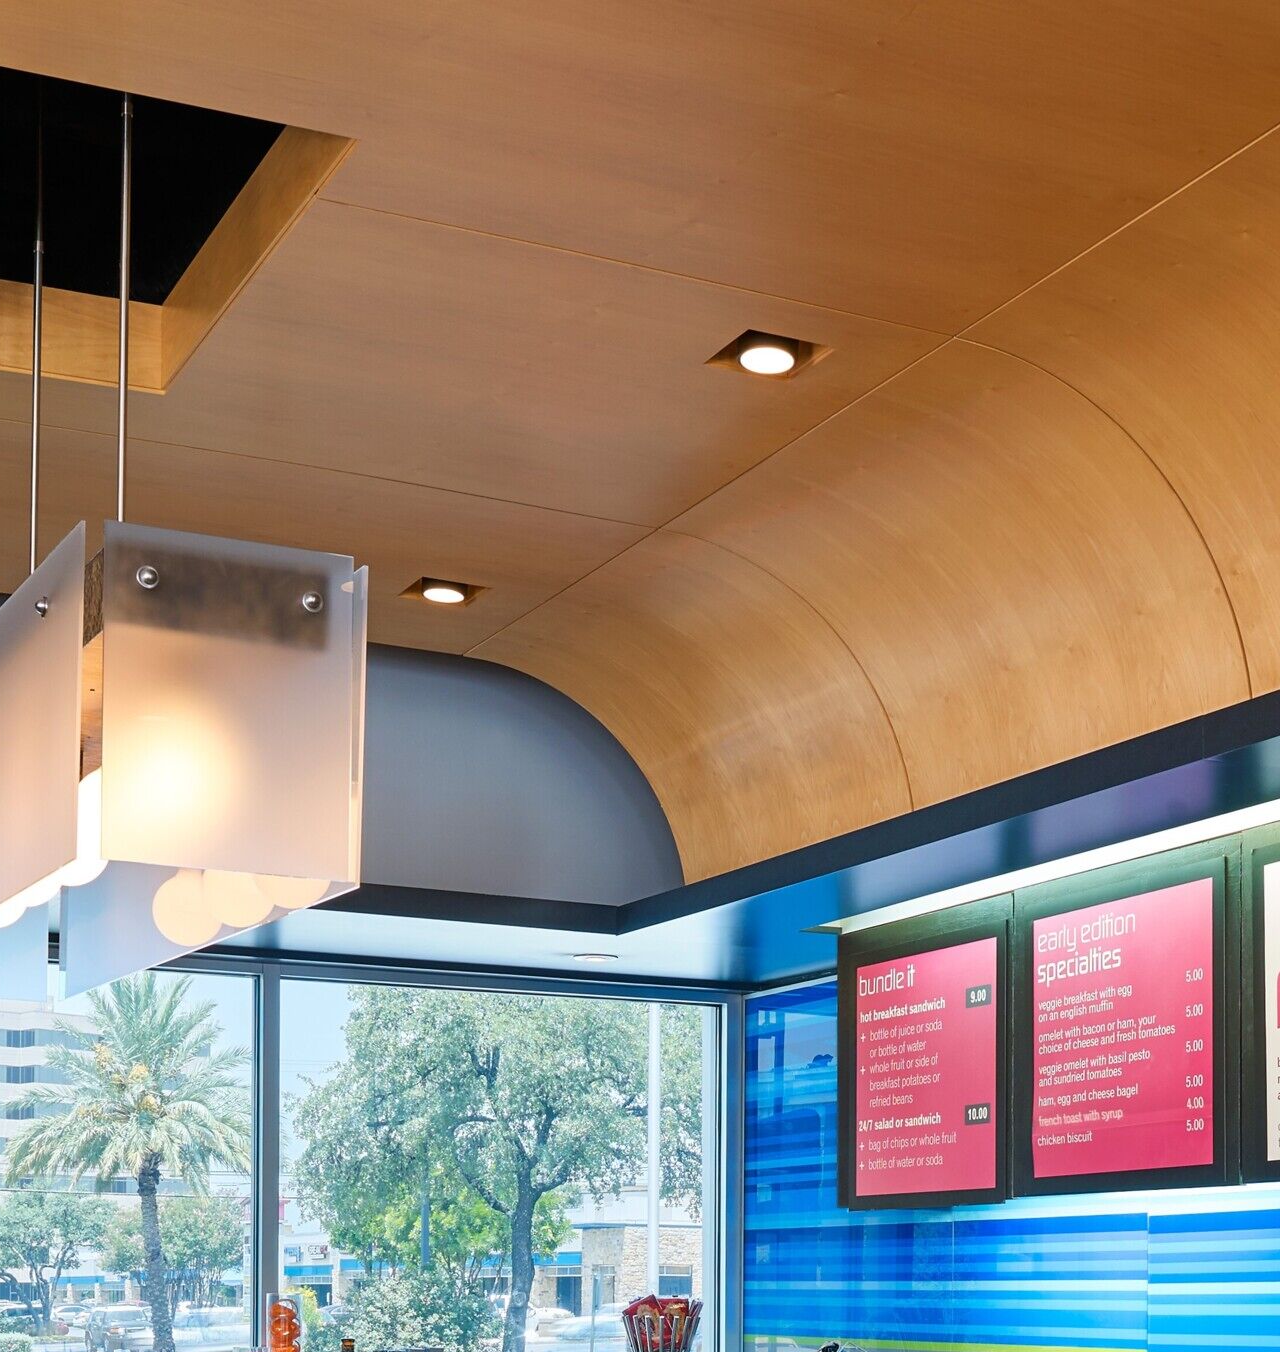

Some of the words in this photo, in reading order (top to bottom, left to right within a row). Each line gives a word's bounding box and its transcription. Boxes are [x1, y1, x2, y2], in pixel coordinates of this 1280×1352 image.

[1038, 926, 1076, 952] early
[1081, 913, 1135, 943] edition
[860, 968, 904, 996] bundle
[907, 964, 915, 987] it
[1038, 948, 1121, 986] specialties
[1039, 998, 1062, 1011] veggie
[1064, 990, 1098, 1005] breakfast
[1099, 987, 1117, 999] with
[1118, 985, 1132, 997] egg
[1186, 968, 1203, 982] 5.00
[861, 1011, 871, 1022] hot
[874, 1005, 907, 1020] breakfast
[910, 998, 945, 1014] sandwich
[971, 989, 986, 1003] 9.00
[1186, 1004, 1203, 1017] 5.00
[1186, 1039, 1203, 1052] 5.00
[1186, 1075, 1203, 1087] 5.00
[1187, 1097, 1204, 1109] 4.00
[875, 1117, 893, 1130] salad
[895, 1119, 903, 1128] or
[905, 1112, 941, 1126] sandwich
[968, 1107, 987, 1120] 10.00
[1038, 1134, 1065, 1146] chicken
[1067, 1131, 1092, 1143] biscuit
[1187, 1119, 1204, 1131] 5.00
